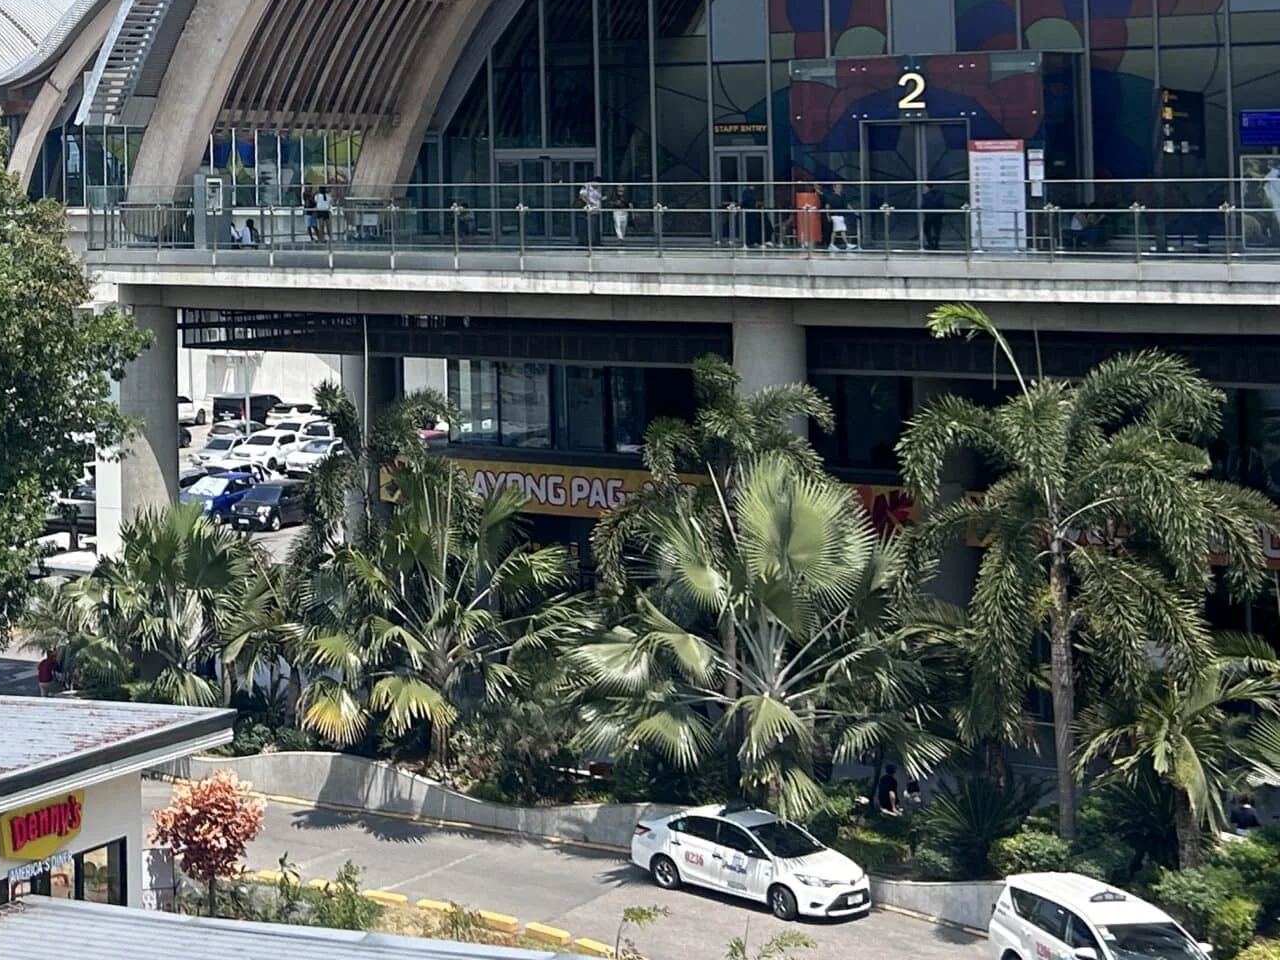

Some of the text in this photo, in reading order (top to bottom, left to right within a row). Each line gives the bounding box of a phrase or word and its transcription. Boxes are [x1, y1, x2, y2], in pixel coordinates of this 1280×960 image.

[898, 72, 926, 109] 2
[714, 124, 767, 133] STAFF ENTRY
[10, 795, 81, 852] Denny's
[9, 849, 73, 882] AMERICA'S DINER
